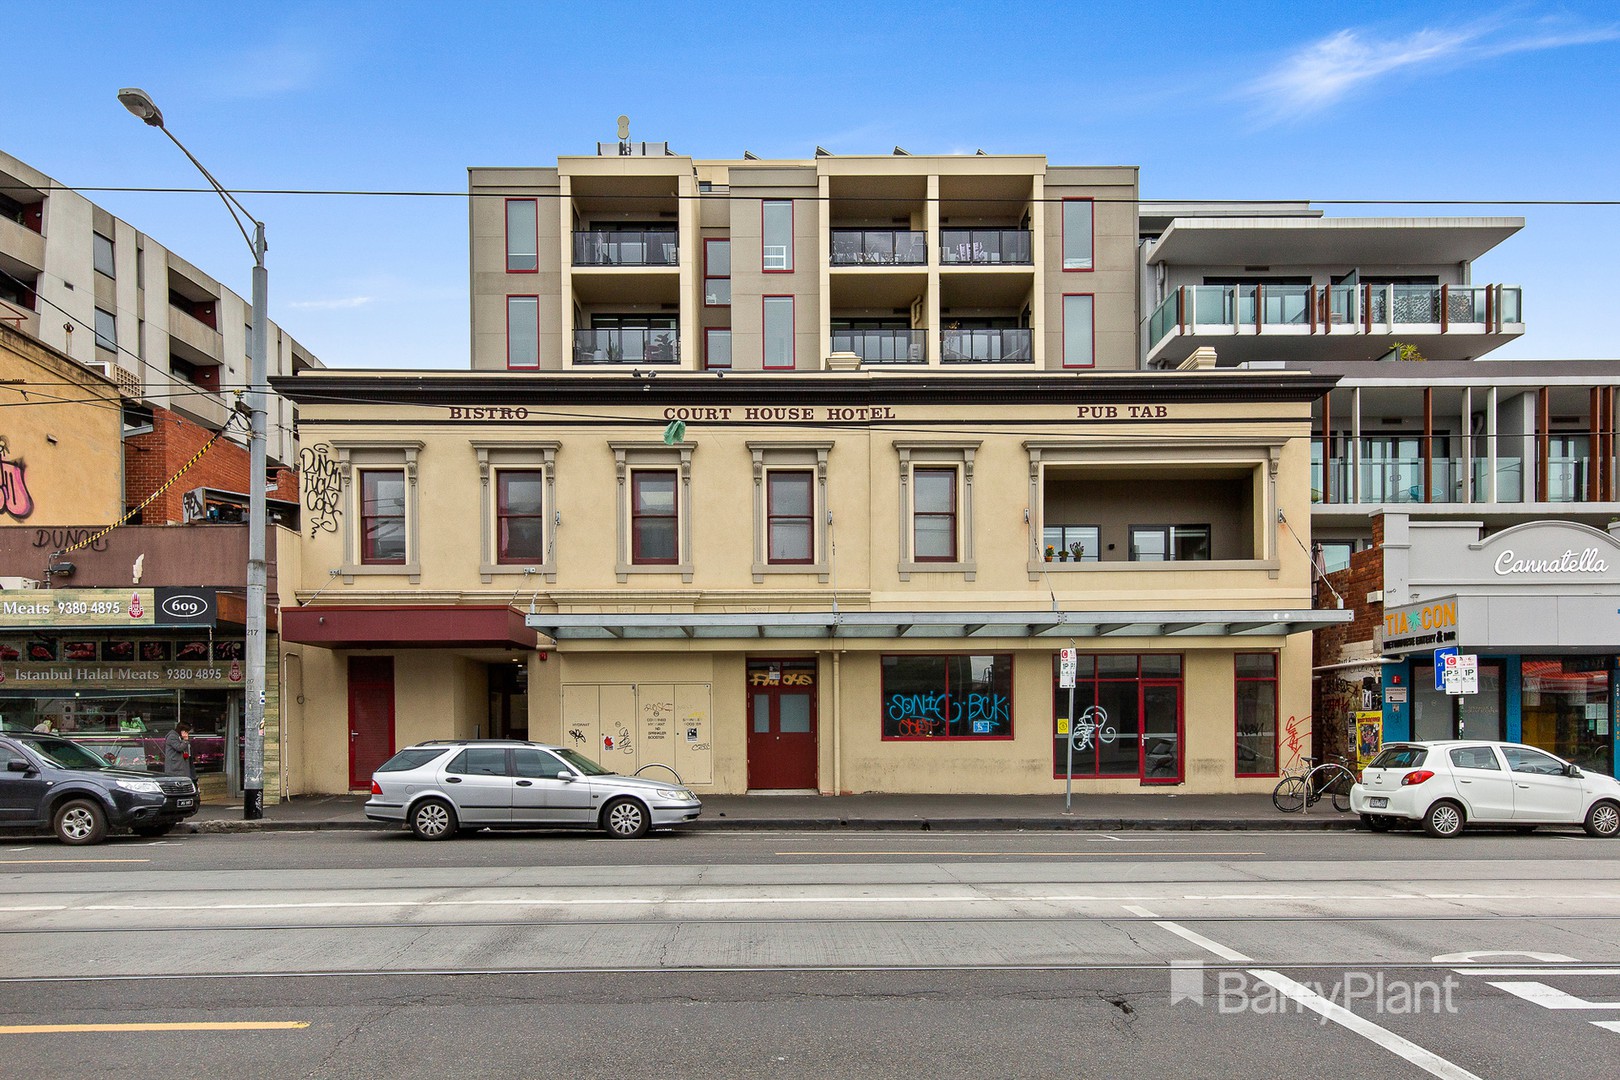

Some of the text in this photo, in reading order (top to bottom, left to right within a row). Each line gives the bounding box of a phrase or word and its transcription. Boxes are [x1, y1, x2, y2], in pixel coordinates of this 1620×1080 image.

[449, 407, 529, 420] BISTRO
[663, 407, 896, 420] COURT HOUSE HOTEL
[1077, 406, 1168, 418] PUB TAB
[1494, 548, 1609, 576] Cannatella
[3, 601, 120, 614] Meats 9380 4895
[172, 600, 198, 614] 609
[1385, 601, 1456, 636] TIA CON
[15, 668, 221, 680] Istanbul Halal Meats 9380 4895
